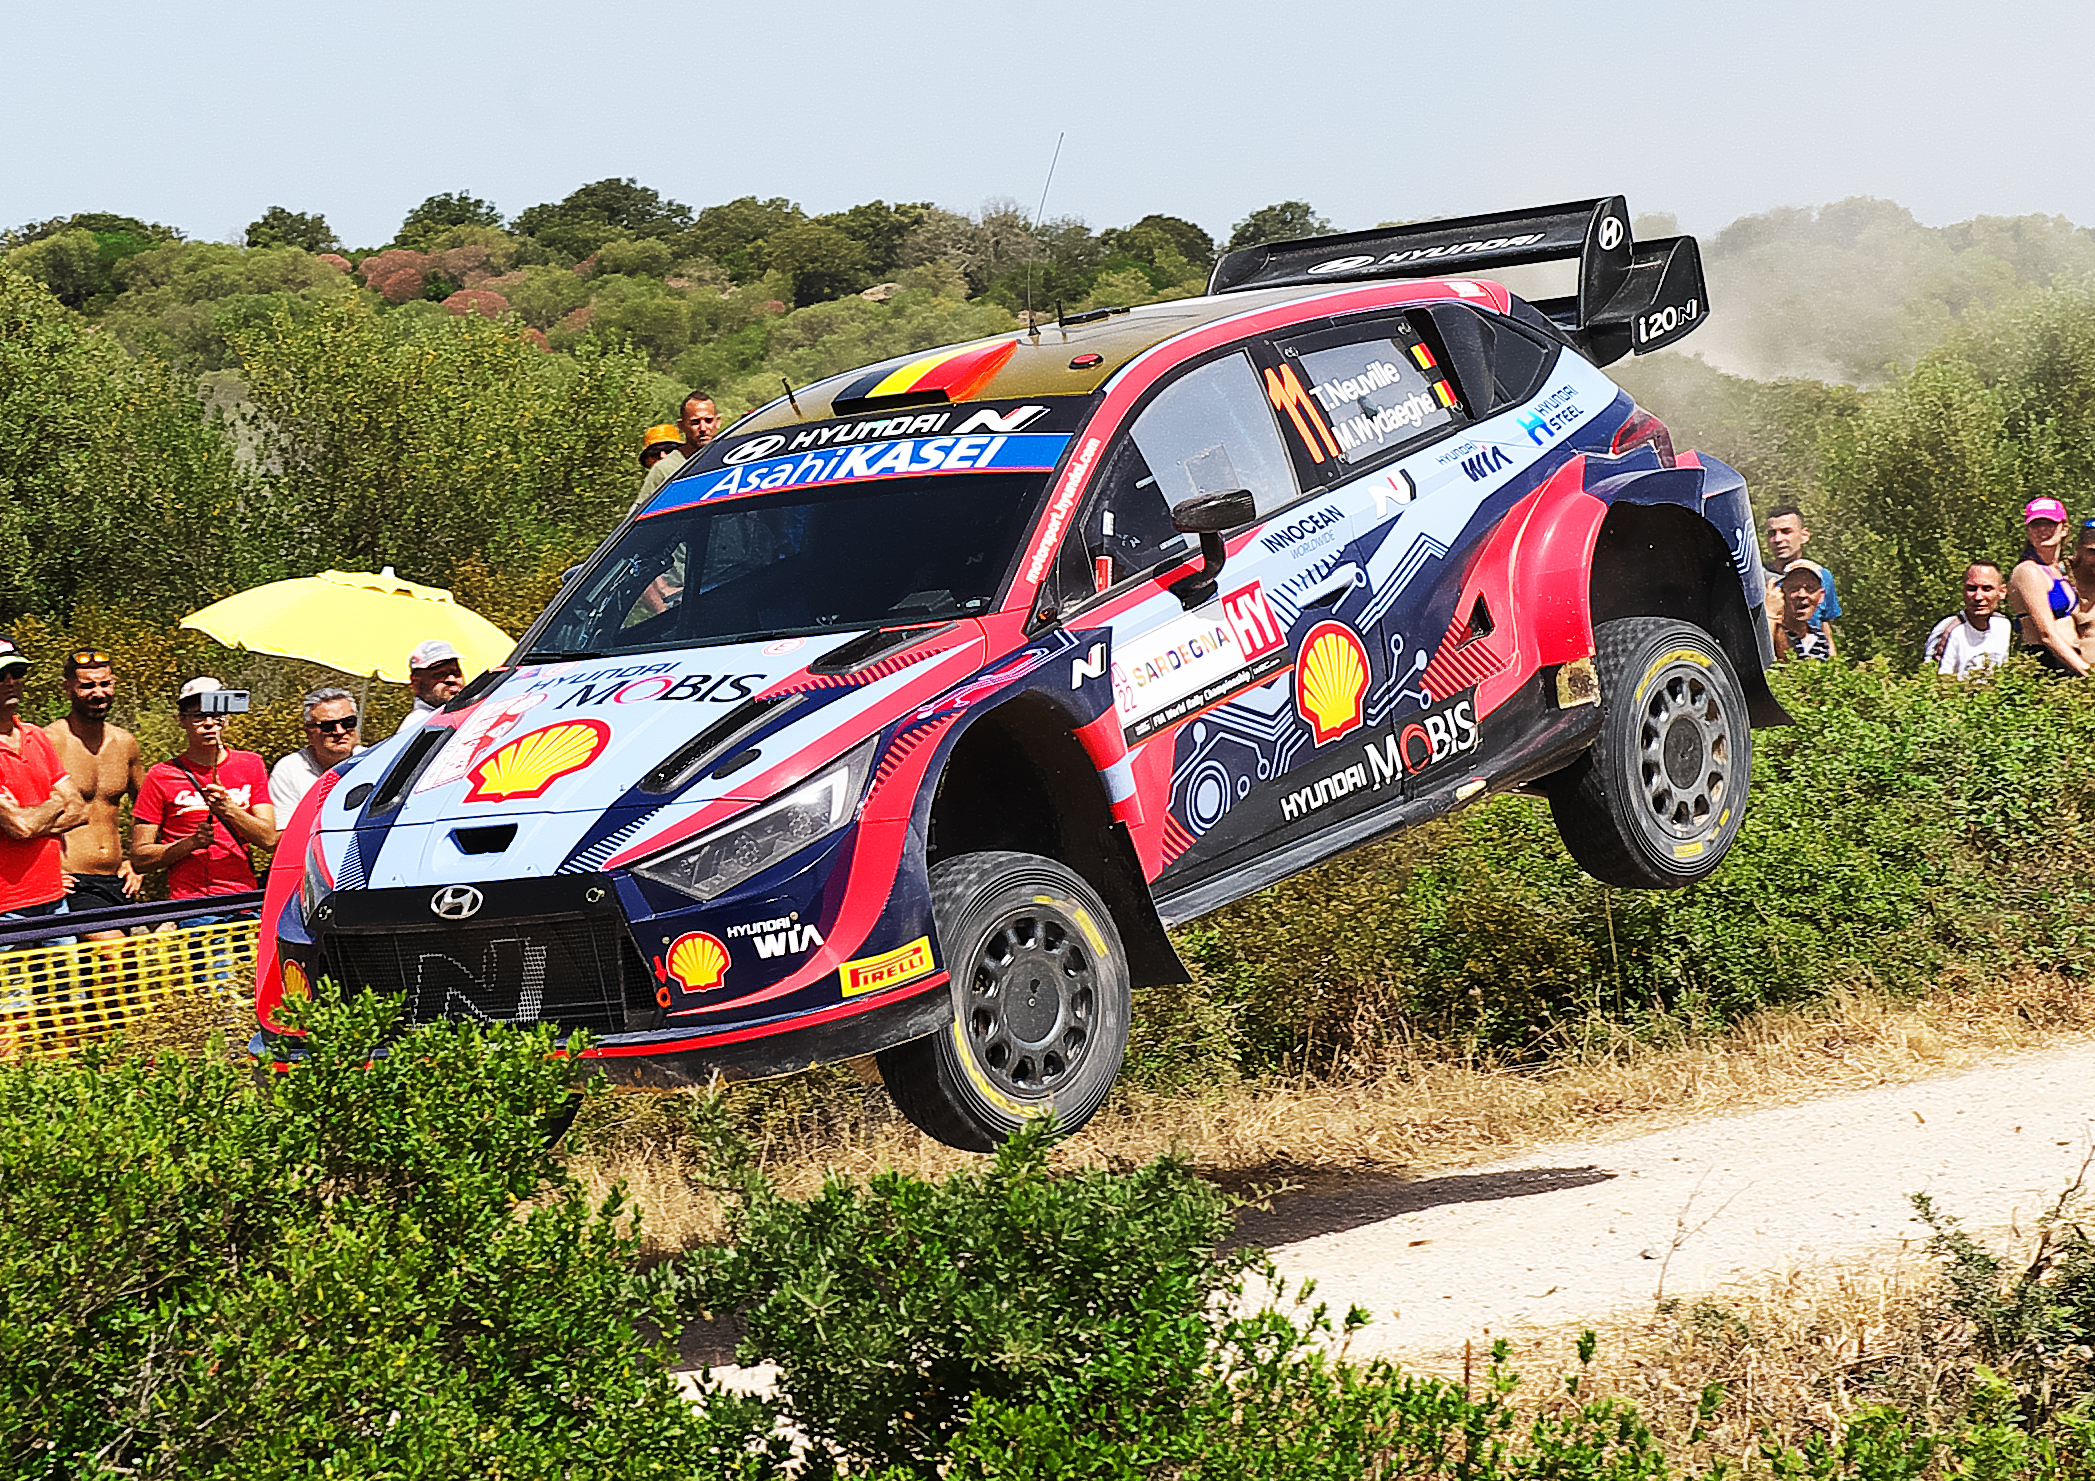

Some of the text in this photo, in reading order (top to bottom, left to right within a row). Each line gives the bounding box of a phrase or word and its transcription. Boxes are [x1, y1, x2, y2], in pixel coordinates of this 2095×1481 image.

[1378, 233, 1546, 265] HYUNDAI
[1308, 360, 1401, 412] T.Neuville
[1535, 383, 1581, 417] HYUNDAI
[788, 413, 951, 450] HYUNDAI
[1263, 362, 1340, 465] 11
[1330, 391, 1437, 453] M.Wydaeghe
[1552, 404, 1586, 432] STEEL
[1435, 441, 1478, 466] HYUNDAI
[1460, 444, 1514, 482] WIA
[1025, 437, 1102, 585] motorsport.hyundai.com
[1260, 504, 1346, 554] INNOCEAN
[1289, 529, 1336, 560] WORLDWIDE
[1224, 588, 1279, 656] HY
[1132, 626, 1231, 687] SARDEGNA
[524, 661, 684, 693] HYUNDAI
[552, 674, 768, 710] MOBIS
[1165, 701, 1187, 720] World
[1185, 694, 1204, 710] Rally
[1203, 670, 1250, 701] Championship
[1118, 685, 1138, 713] 22
[1280, 700, 1479, 822] HYUNDAI MOBIS
[727, 916, 792, 939] HYUNDAI
[753, 923, 825, 960] WIA
[851, 944, 926, 988] PIRELLI
